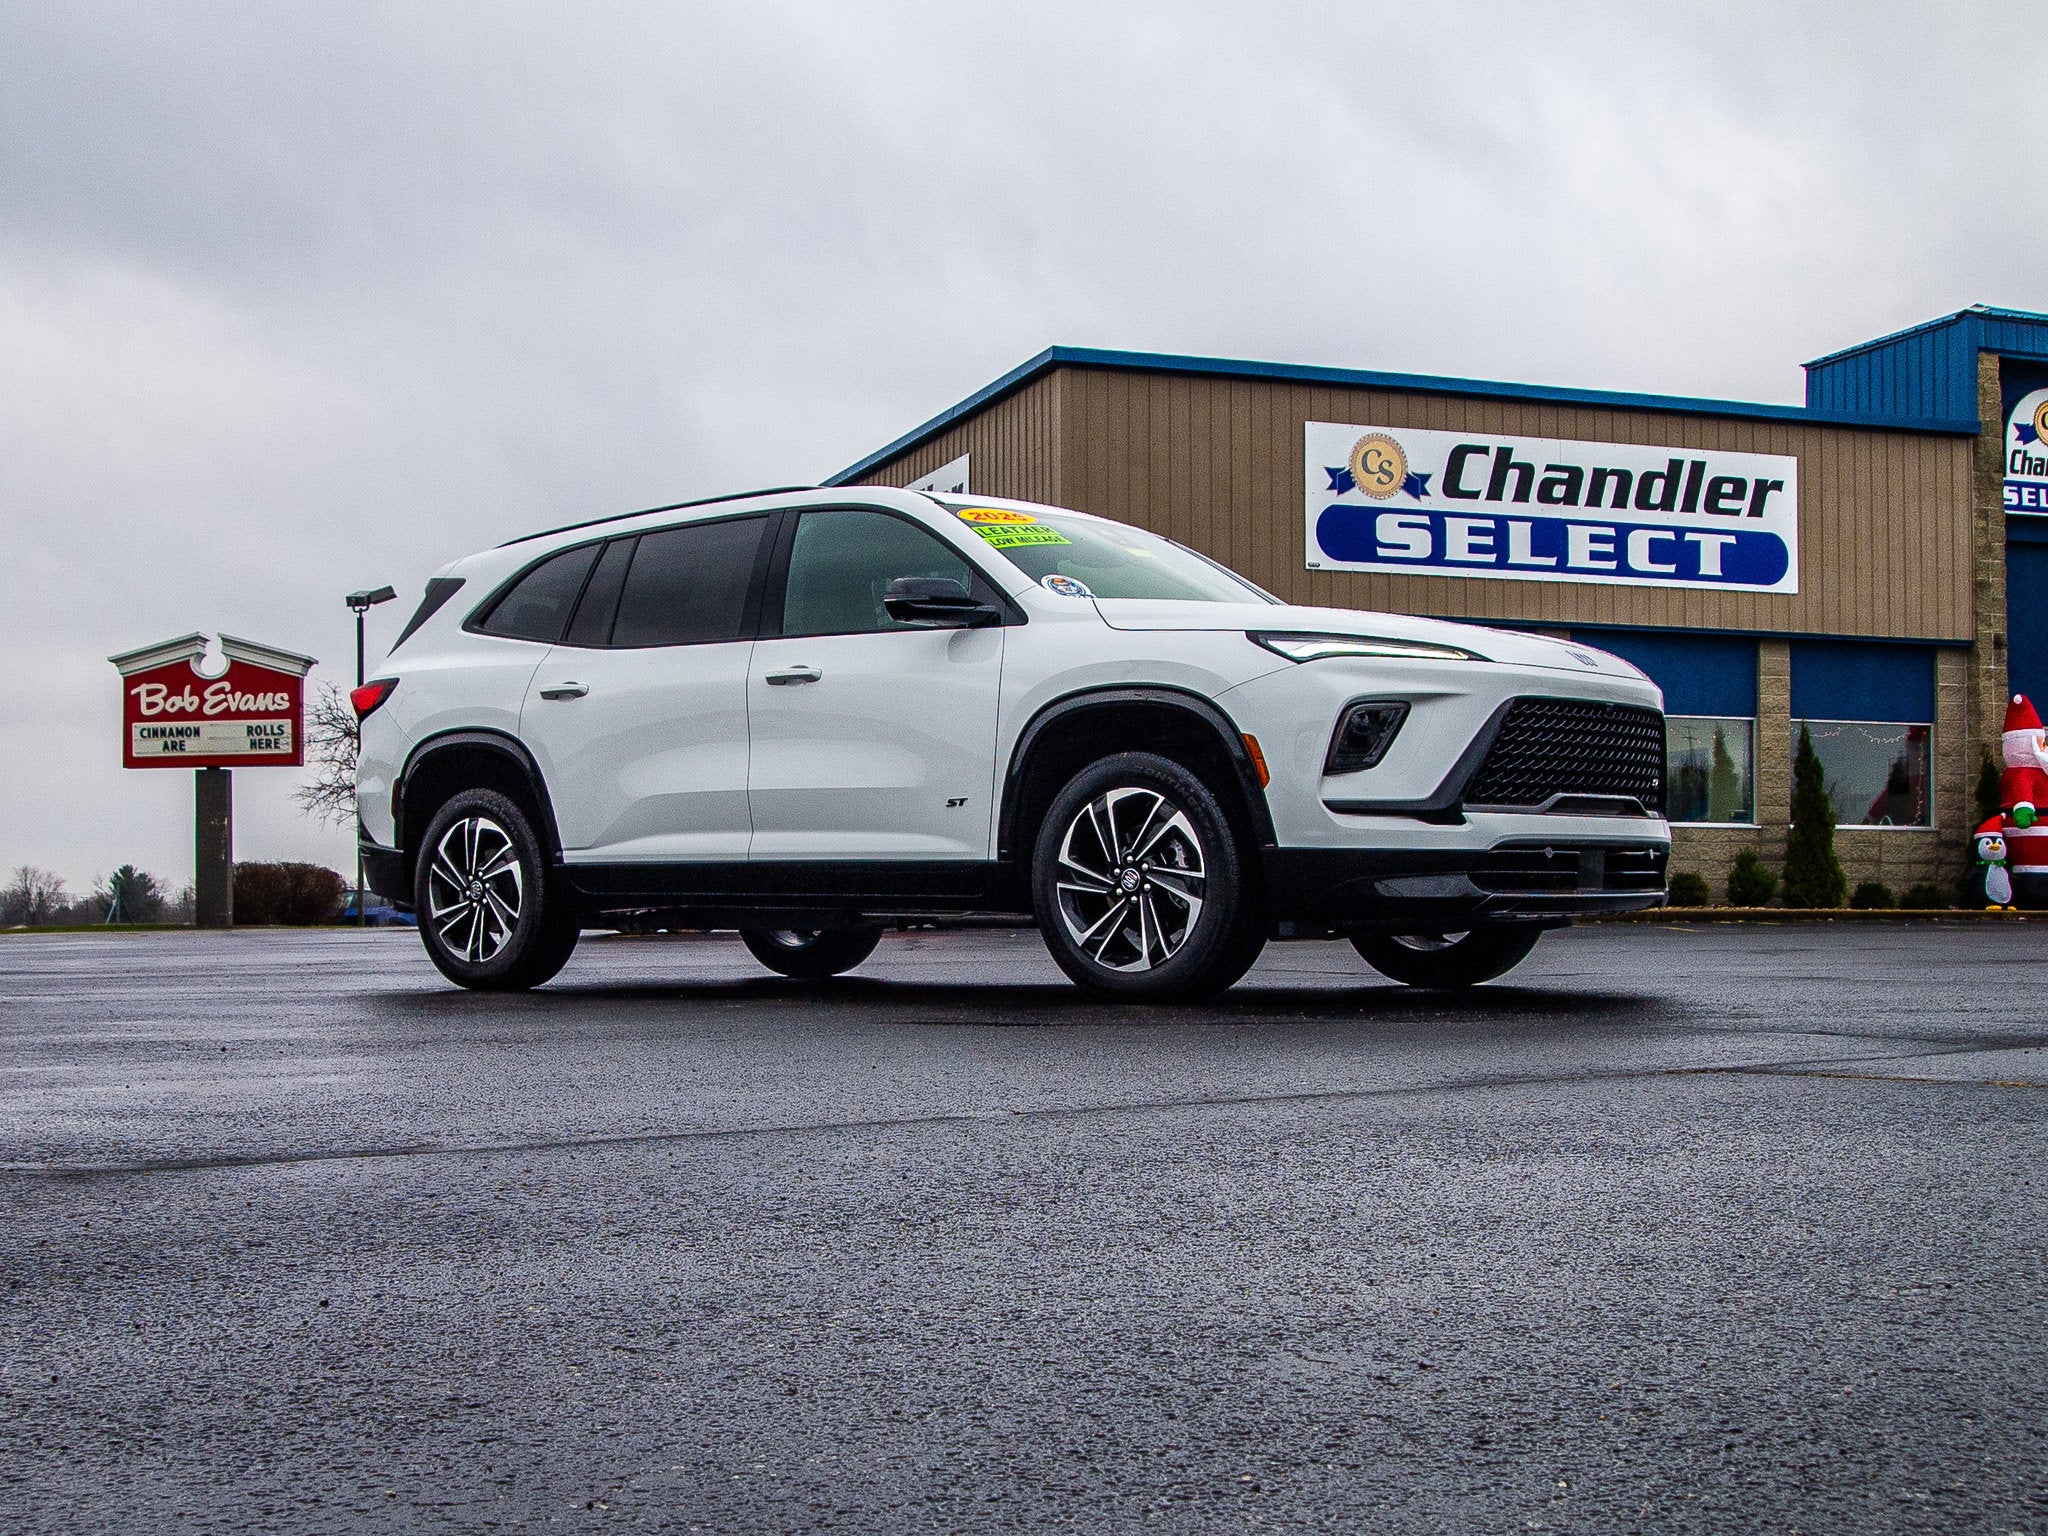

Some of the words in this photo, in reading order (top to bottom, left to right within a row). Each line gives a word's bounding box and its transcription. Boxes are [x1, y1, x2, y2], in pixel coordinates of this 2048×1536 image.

[1361, 448, 1394, 485] CS
[1441, 443, 1784, 518] Chandler
[978, 525, 1056, 537] LEATHER
[990, 536, 1016, 546] LOW
[1016, 534, 1064, 544] MILEAGE
[1375, 513, 1737, 576] SELECT
[131, 683, 199, 716] Bob
[203, 681, 290, 715] Evans
[139, 726, 200, 739] CINNAMON
[246, 724, 285, 736] ROLLS
[162, 739, 186, 751] ARE
[249, 737, 281, 750] HERE
[946, 797, 968, 807] ST
